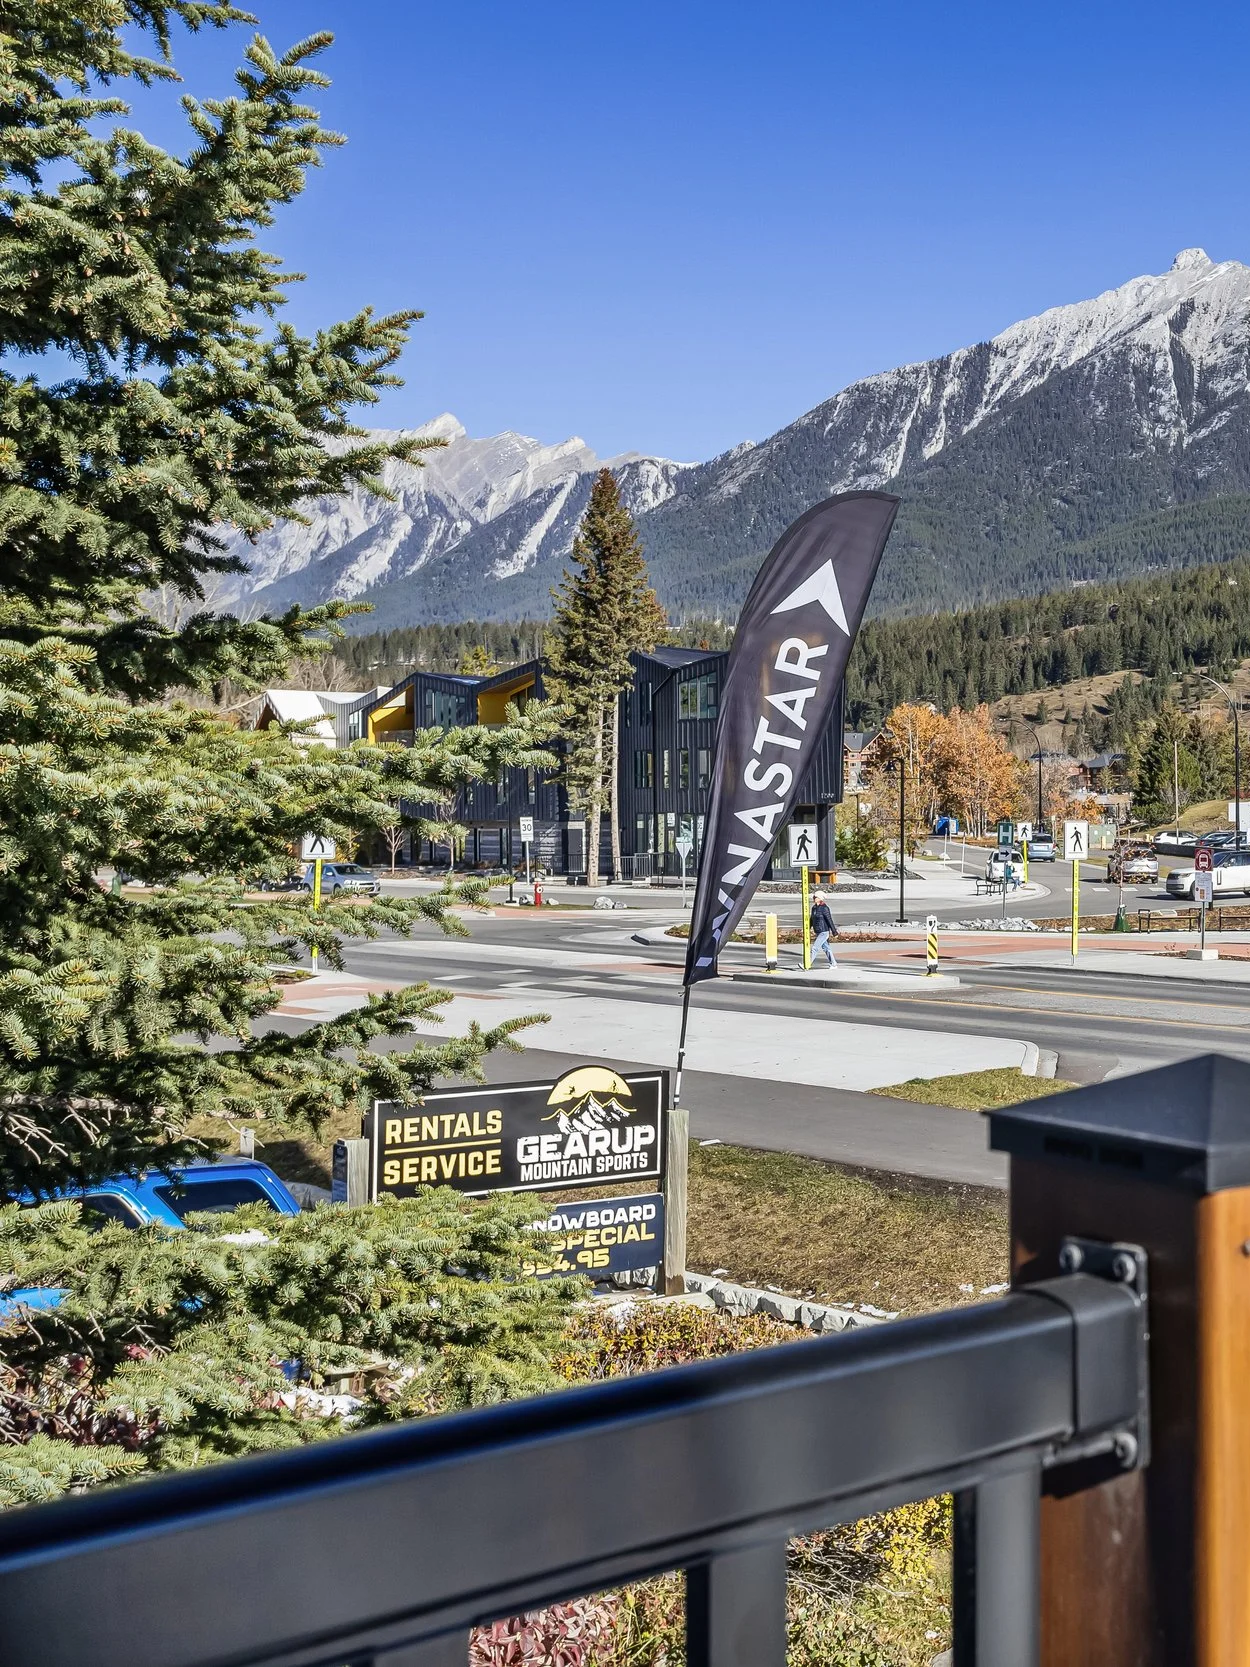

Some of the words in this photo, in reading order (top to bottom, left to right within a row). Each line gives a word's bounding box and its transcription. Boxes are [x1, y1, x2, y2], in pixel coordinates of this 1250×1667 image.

[522, 823, 532, 832] 30
[1000, 825, 1012, 843] H
[385, 1110, 502, 1145] RENTALS
[517, 1124, 655, 1164] GEARUP
[384, 1149, 501, 1185] SERVICE
[520, 1158, 592, 1182] MOUNTAIN
[596, 1151, 648, 1173] SPORTS
